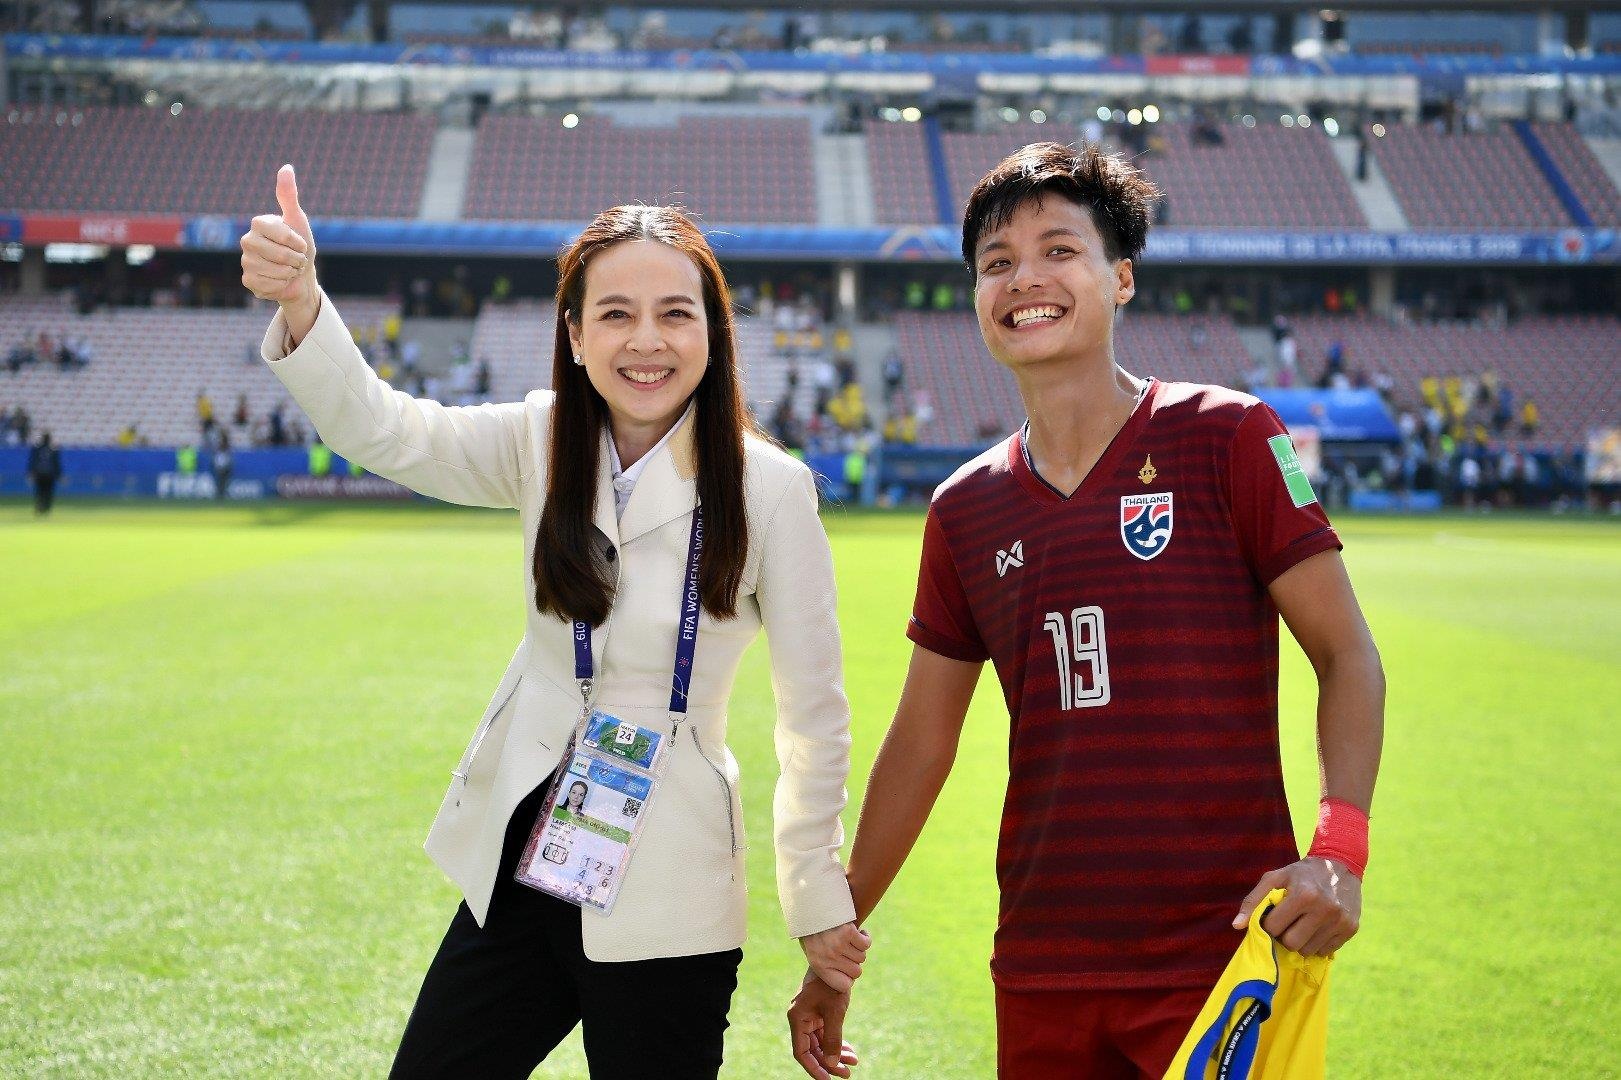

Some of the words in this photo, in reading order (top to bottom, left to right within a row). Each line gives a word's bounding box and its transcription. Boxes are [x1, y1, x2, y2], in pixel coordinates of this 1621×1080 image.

[1124, 496, 1169, 505] THAILAND
[683, 615, 696, 640] FIFA
[1043, 605, 1111, 711] 19
[619, 731, 632, 741] 24
[595, 861, 602, 871] 2
[605, 865, 614, 875] 3
[578, 869, 587, 879] 4
[601, 878, 609, 888] 6
[585, 885, 593, 895] 8
